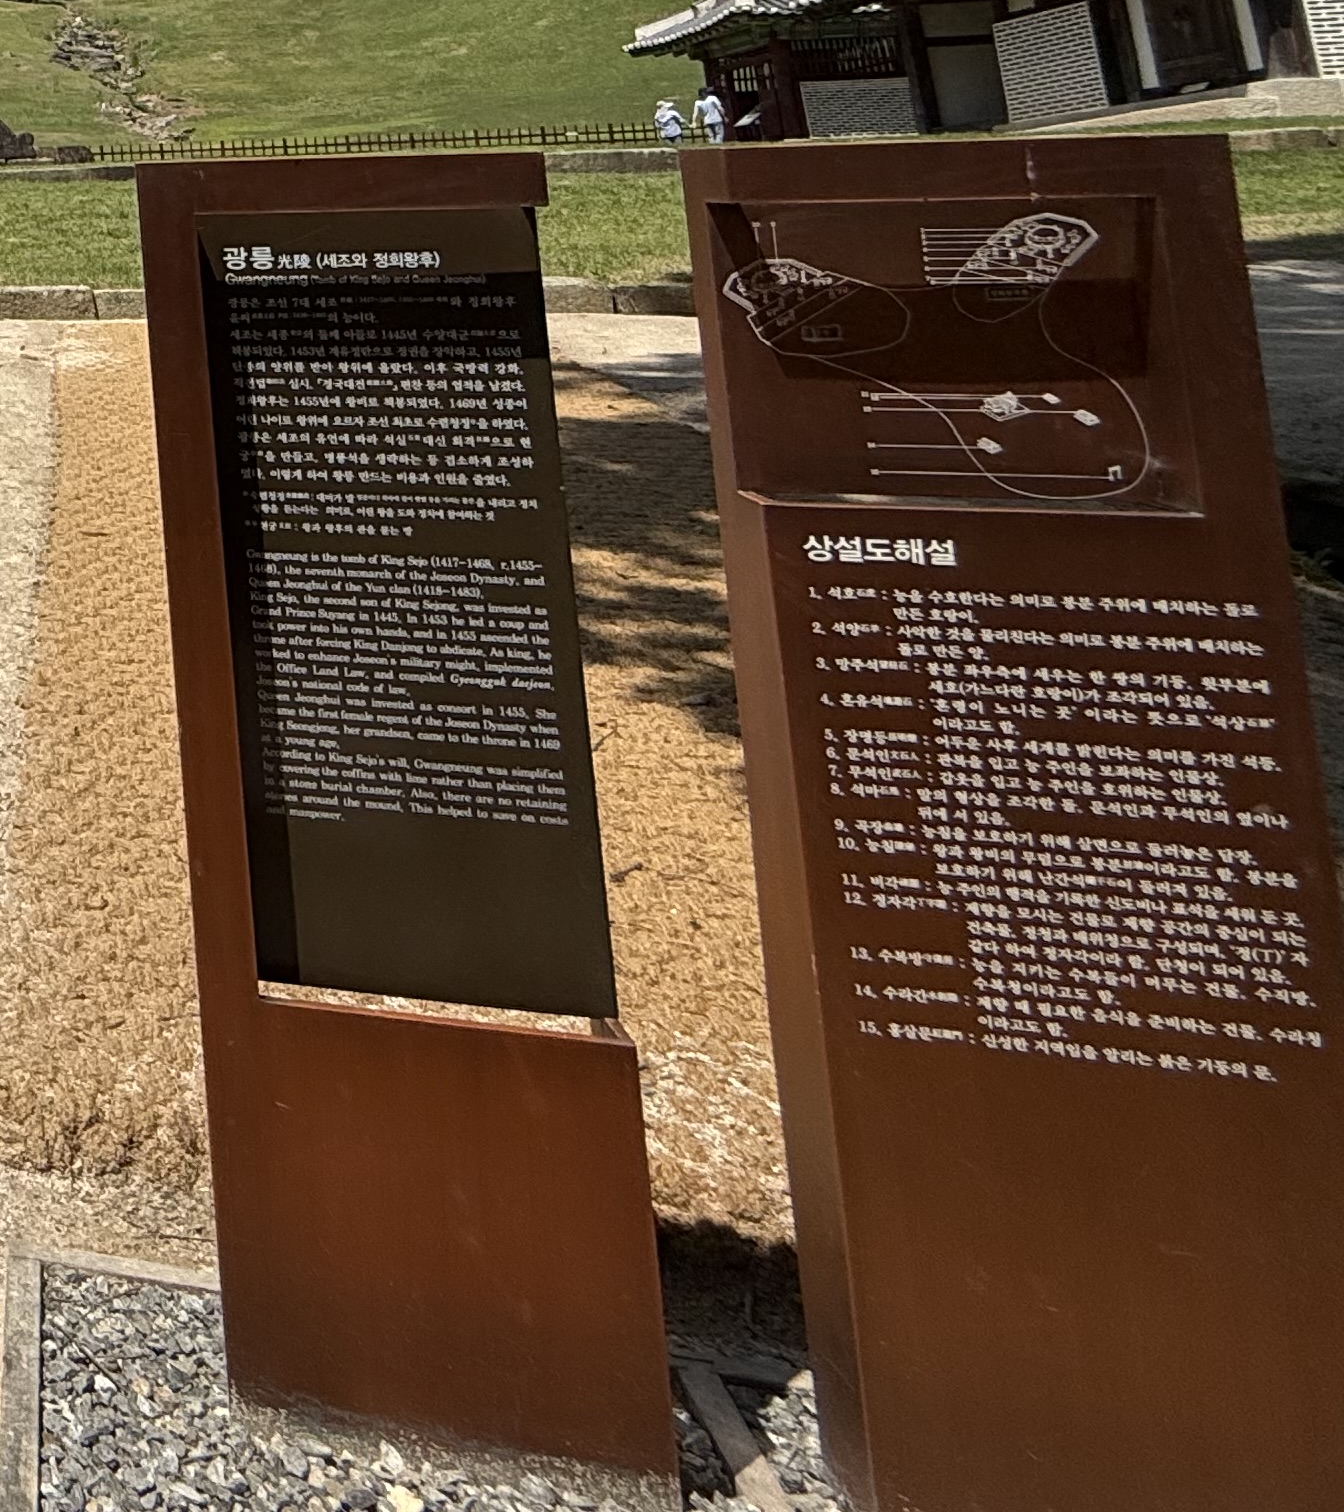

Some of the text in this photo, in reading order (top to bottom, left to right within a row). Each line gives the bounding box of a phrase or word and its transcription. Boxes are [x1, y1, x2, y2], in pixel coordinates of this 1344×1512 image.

[315, 252, 368, 270] (세조와
[372, 250, 441, 269] 정희왕후)
[224, 273, 309, 287] Gwangneung
[340, 553, 367, 564] tomb
[380, 554, 406, 568] King
[406, 554, 429, 569] Sejo
[802, 534, 958, 567] 상설도해설
[304, 566, 346, 578] seventh
[346, 568, 393, 580] monarch
[429, 570, 468, 583] Joseon
[469, 572, 521, 587] Dynasty,
[523, 575, 546, 587] and
[275, 591, 301, 605] Sejo,
[322, 595, 358, 607] second
[394, 597, 420, 612] King
[422, 599, 460, 613] Sejong,
[462, 604, 486, 613] was
[487, 602, 532, 615] invested
[284, 606, 317, 619] Prince
[373, 611, 403, 624] 1445.
[421, 613, 449, 626] 1453
[498, 620, 526, 632] coup
[288, 634, 314, 647] after
[315, 636, 352, 651] forcing
[352, 638, 379, 653] King
[380, 639, 424, 655] Danjong
[439, 643, 488, 658] abdicate.
[506, 646, 536, 662] king,
